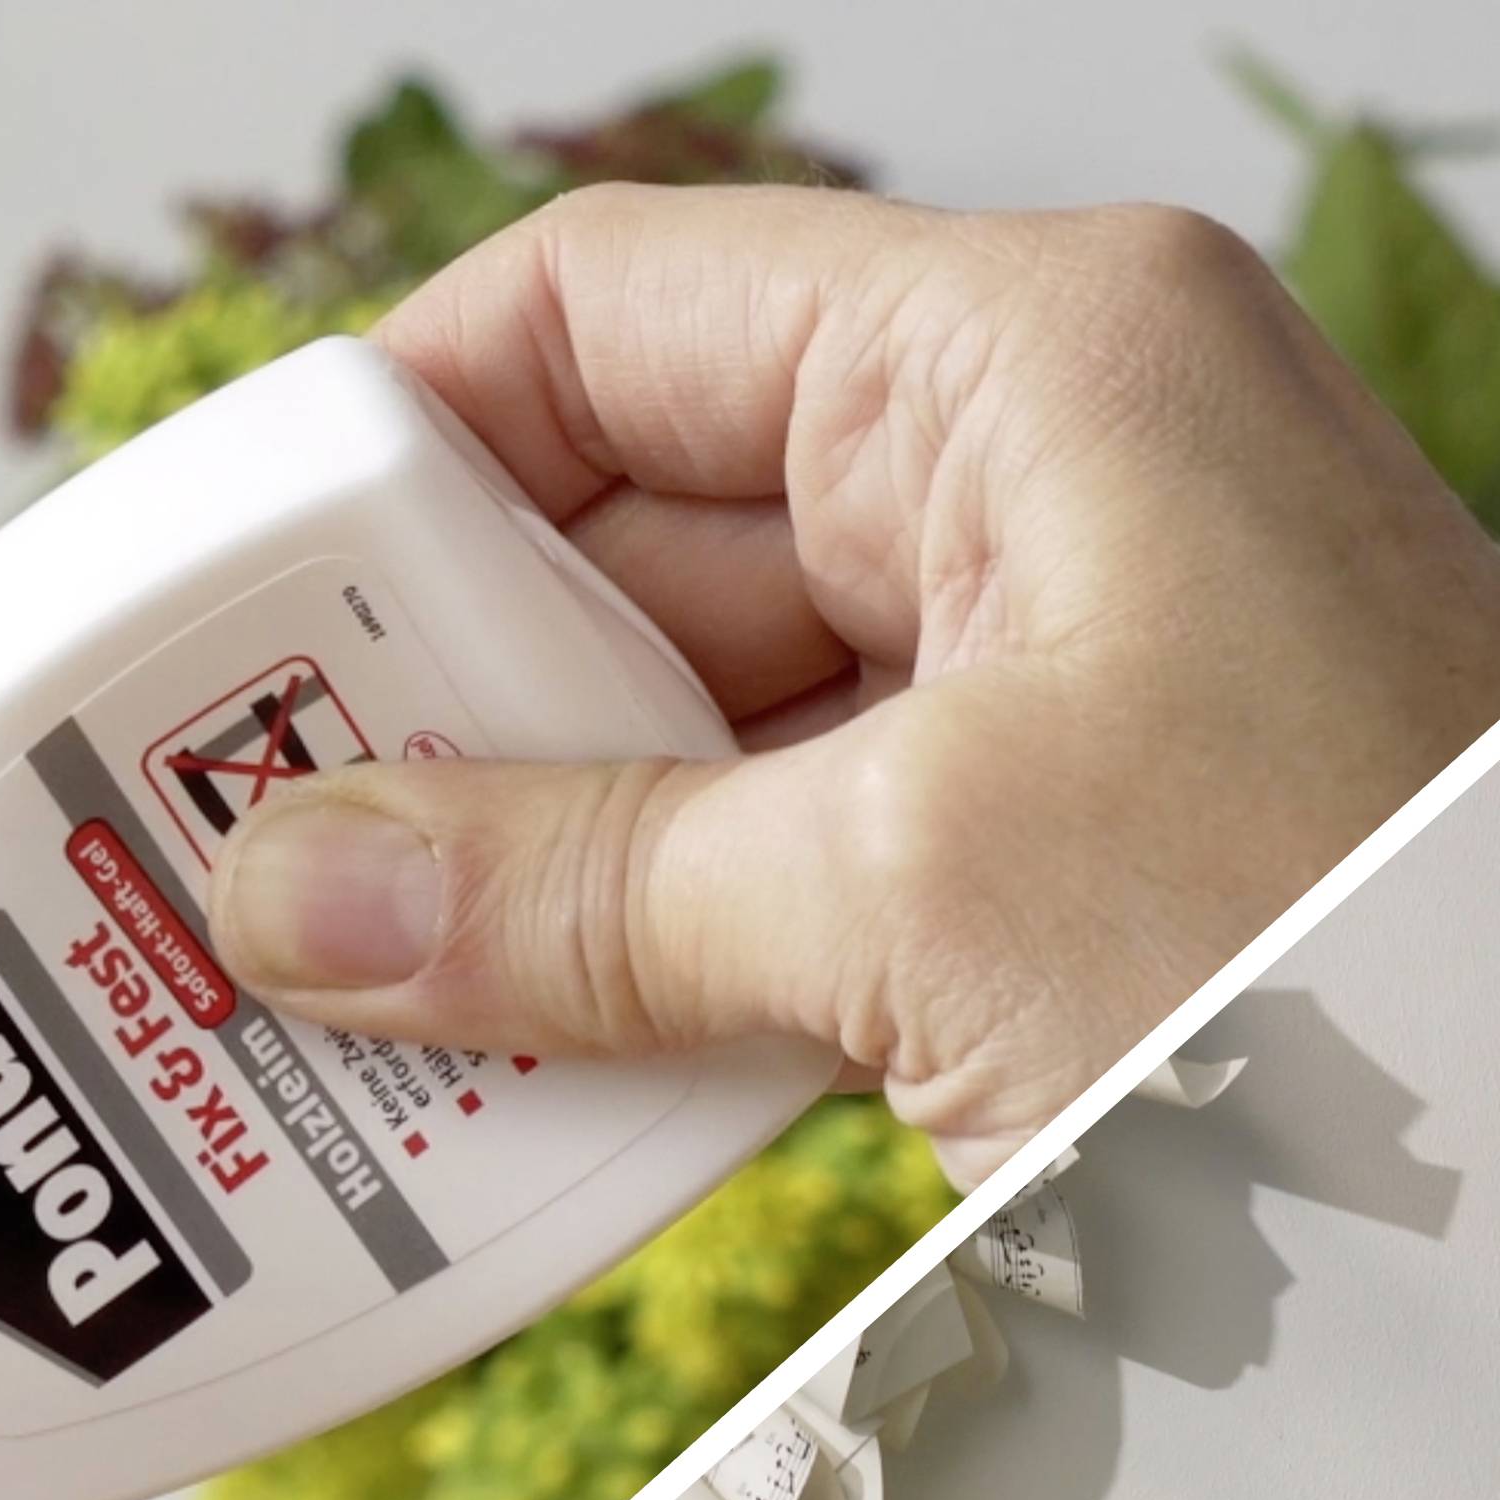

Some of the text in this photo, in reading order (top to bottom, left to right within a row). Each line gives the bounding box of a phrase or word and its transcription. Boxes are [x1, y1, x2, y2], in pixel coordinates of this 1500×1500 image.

[78, 840, 218, 1011] Sofort-Haft-Gel
[65, 921, 270, 1194] Fix & Fest
[241, 1016, 382, 1211] Holzleim
[324, 1025, 409, 1132] Keine Zwi
